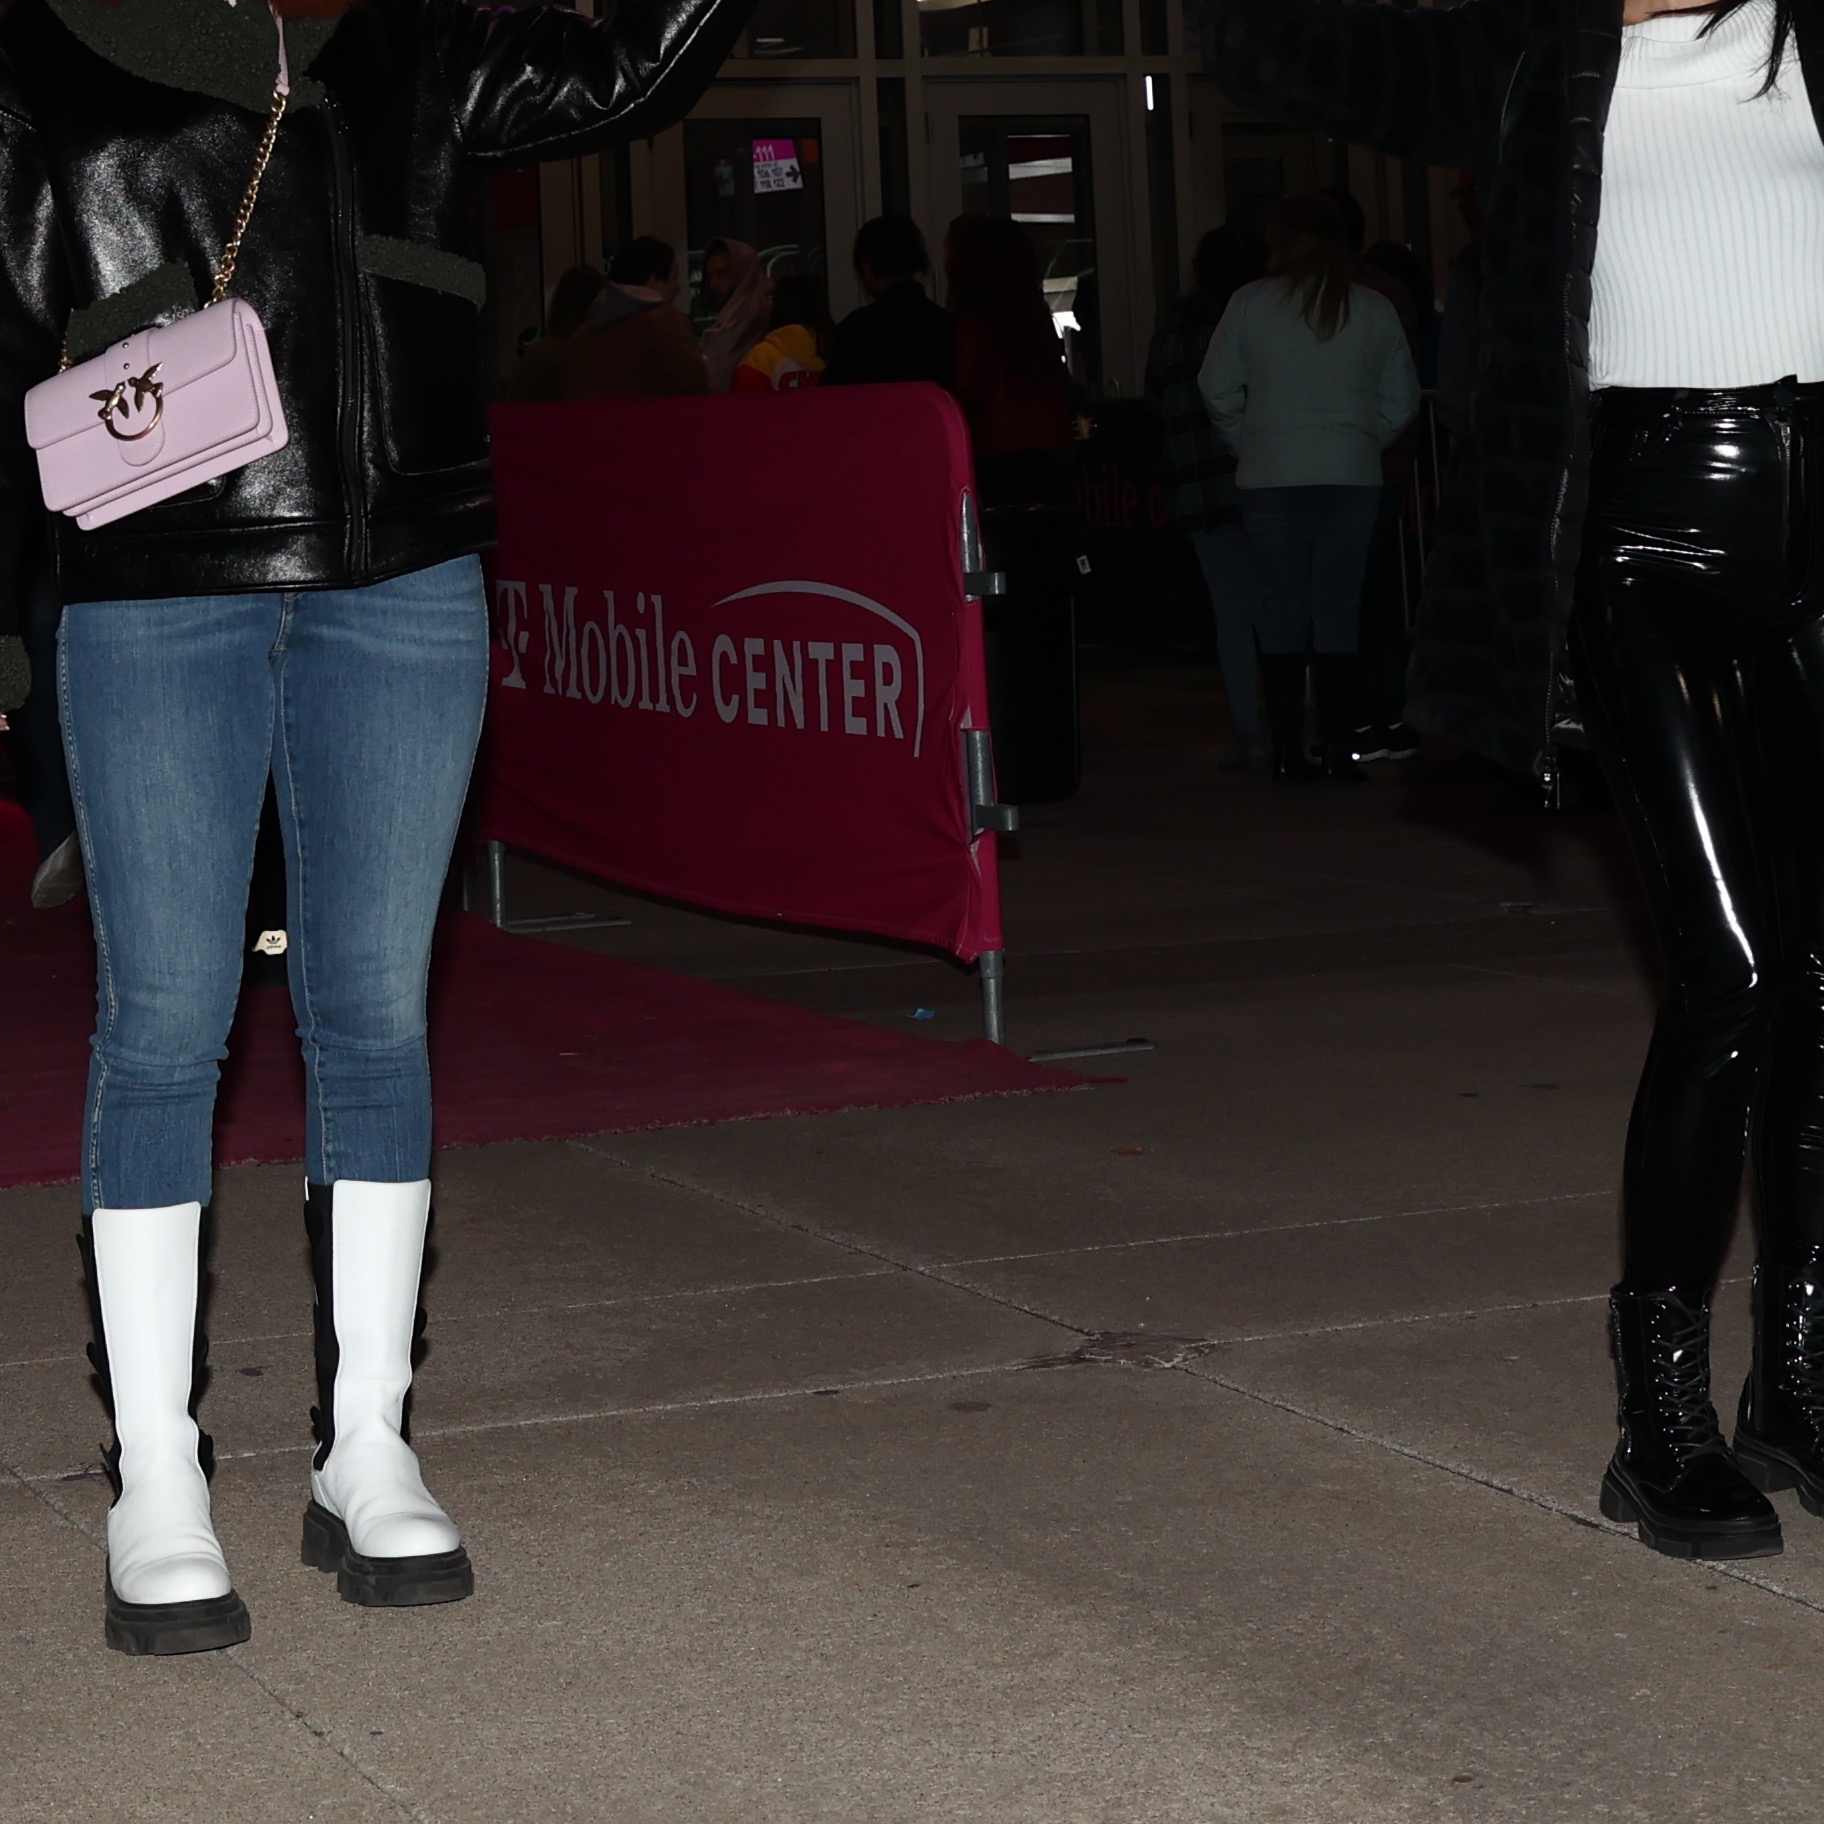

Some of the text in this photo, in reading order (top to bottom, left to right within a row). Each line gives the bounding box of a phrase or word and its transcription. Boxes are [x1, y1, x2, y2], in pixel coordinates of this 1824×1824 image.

[493, 579, 905, 739] T Mobile CENTER
